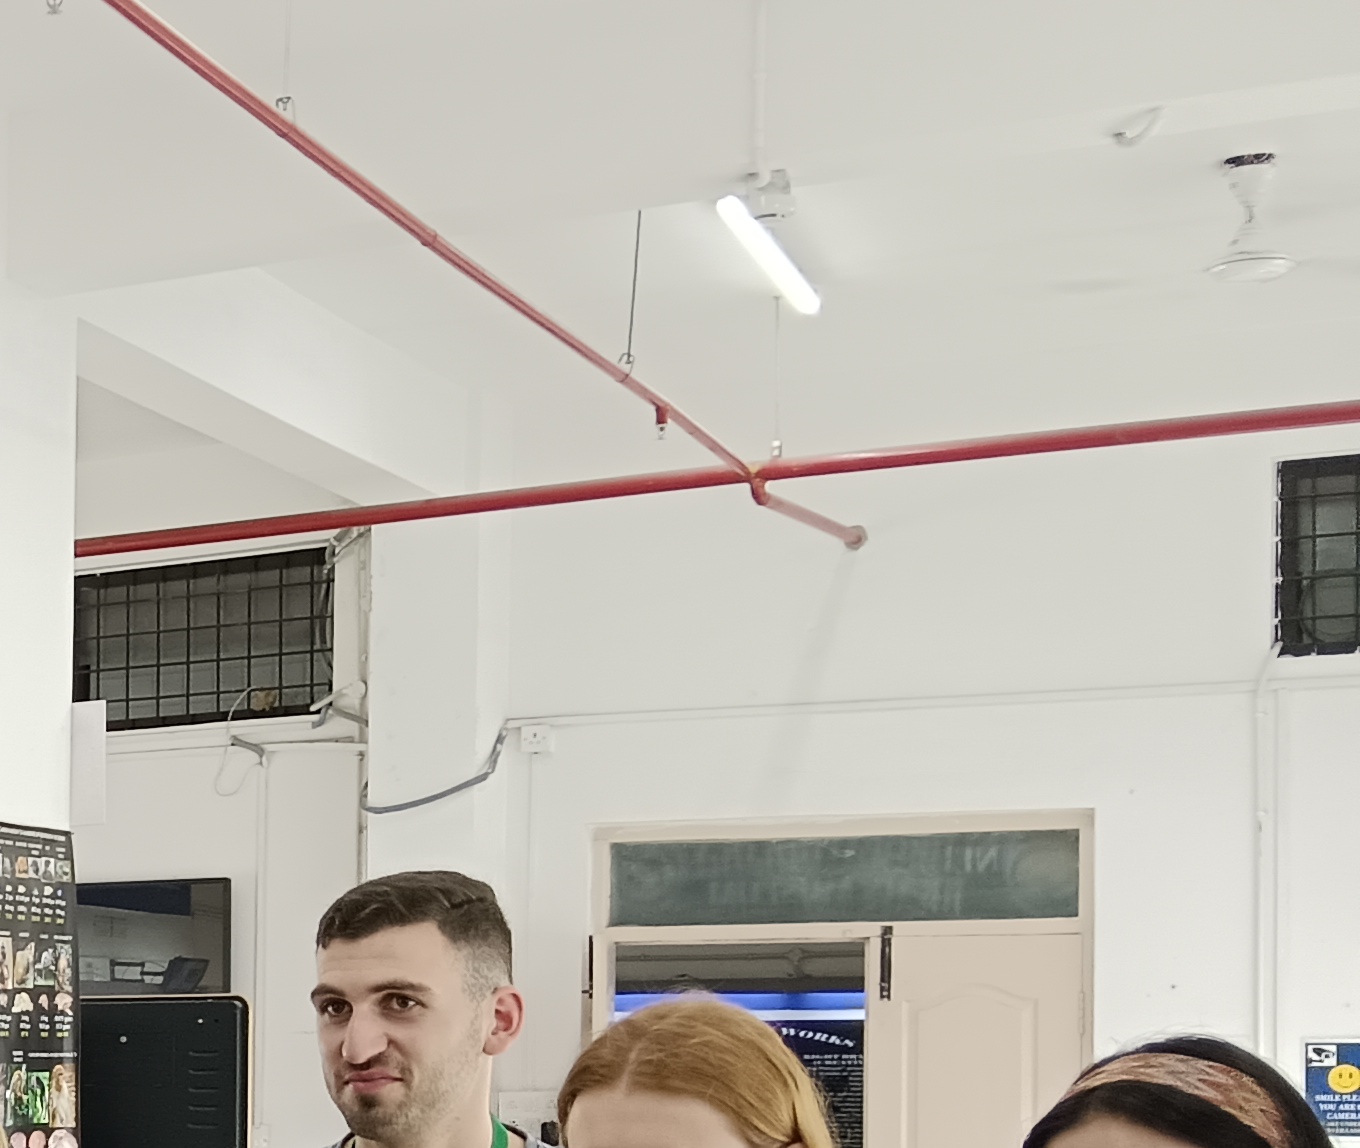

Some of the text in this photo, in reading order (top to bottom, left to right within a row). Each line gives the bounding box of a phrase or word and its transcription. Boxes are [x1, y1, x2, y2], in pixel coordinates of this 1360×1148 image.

[781, 1027, 856, 1048] WORKS
[1315, 1094, 1341, 1102] SMILE
[1319, 1103, 1336, 1111] YOU
